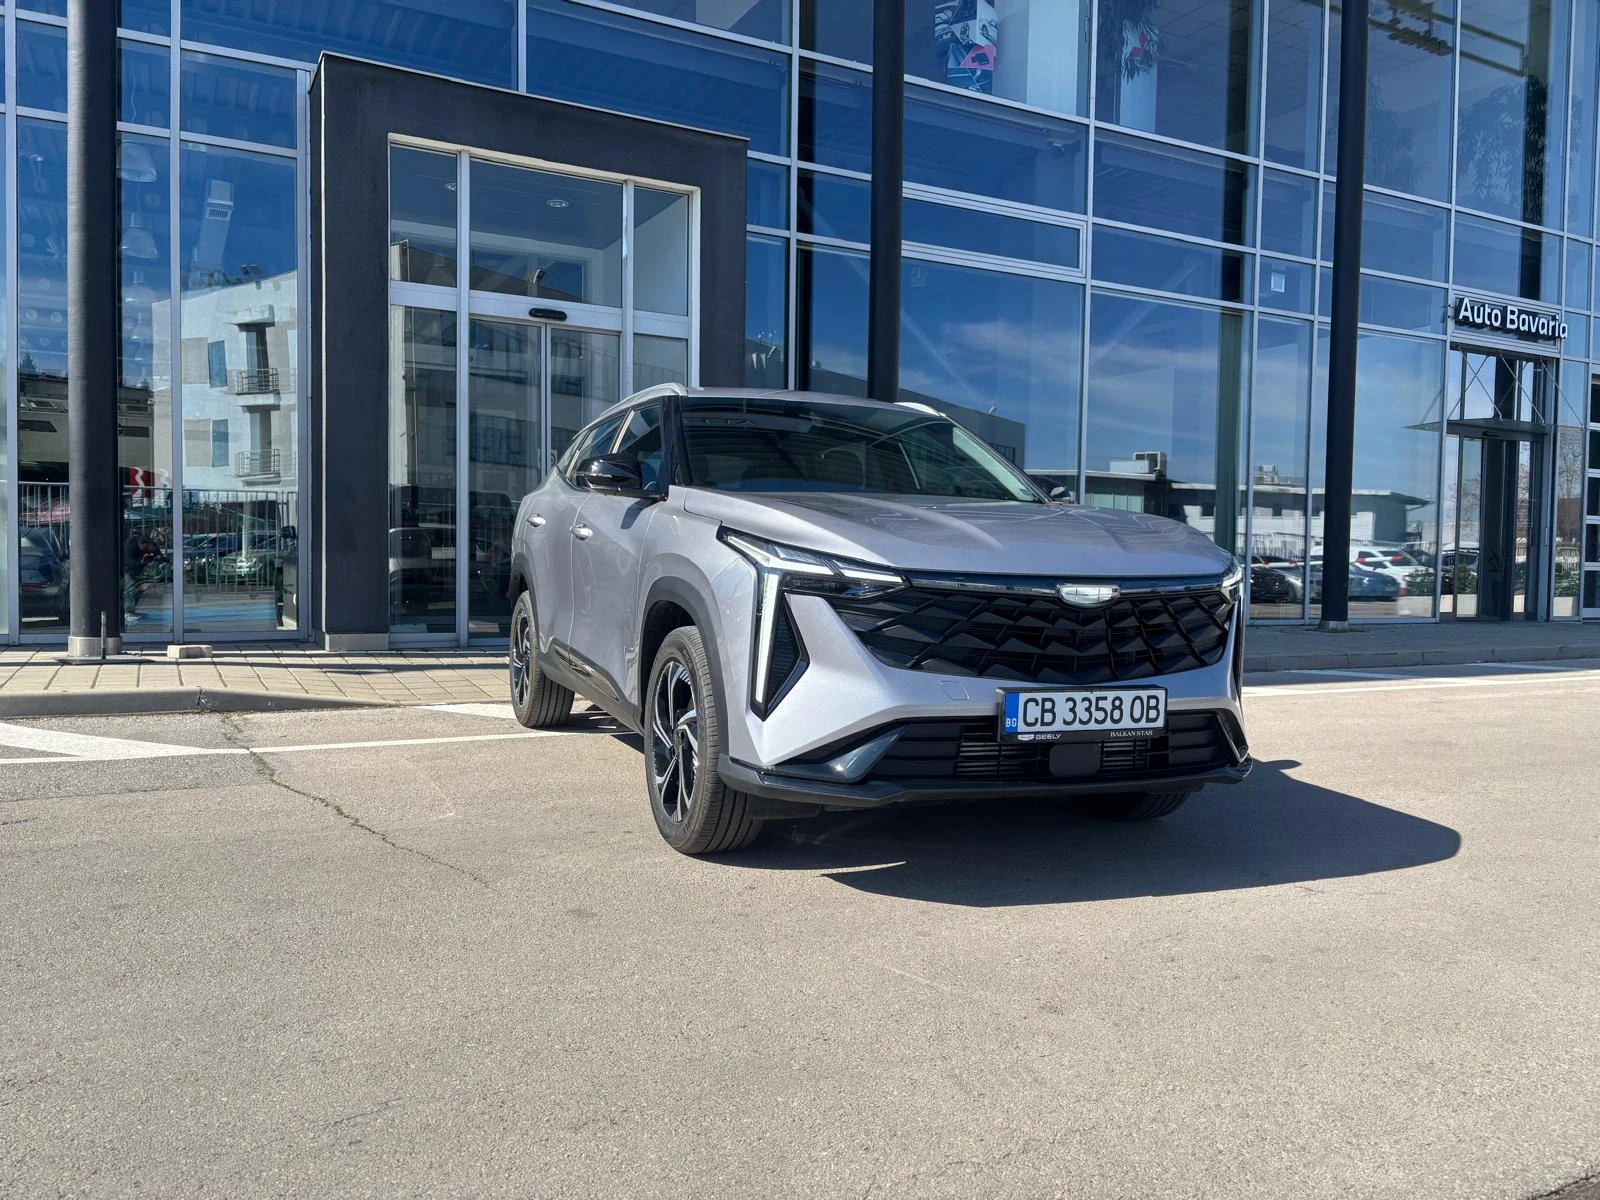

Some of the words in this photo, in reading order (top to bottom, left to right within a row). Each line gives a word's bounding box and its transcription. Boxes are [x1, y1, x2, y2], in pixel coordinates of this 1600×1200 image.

[1459, 297, 1502, 327] Auto
[1506, 305, 1568, 339] Bavaria
[1006, 718, 1017, 728] BG
[1022, 697, 1057, 728] CB
[1062, 696, 1124, 726] 3358
[1129, 695, 1161, 724] OB
